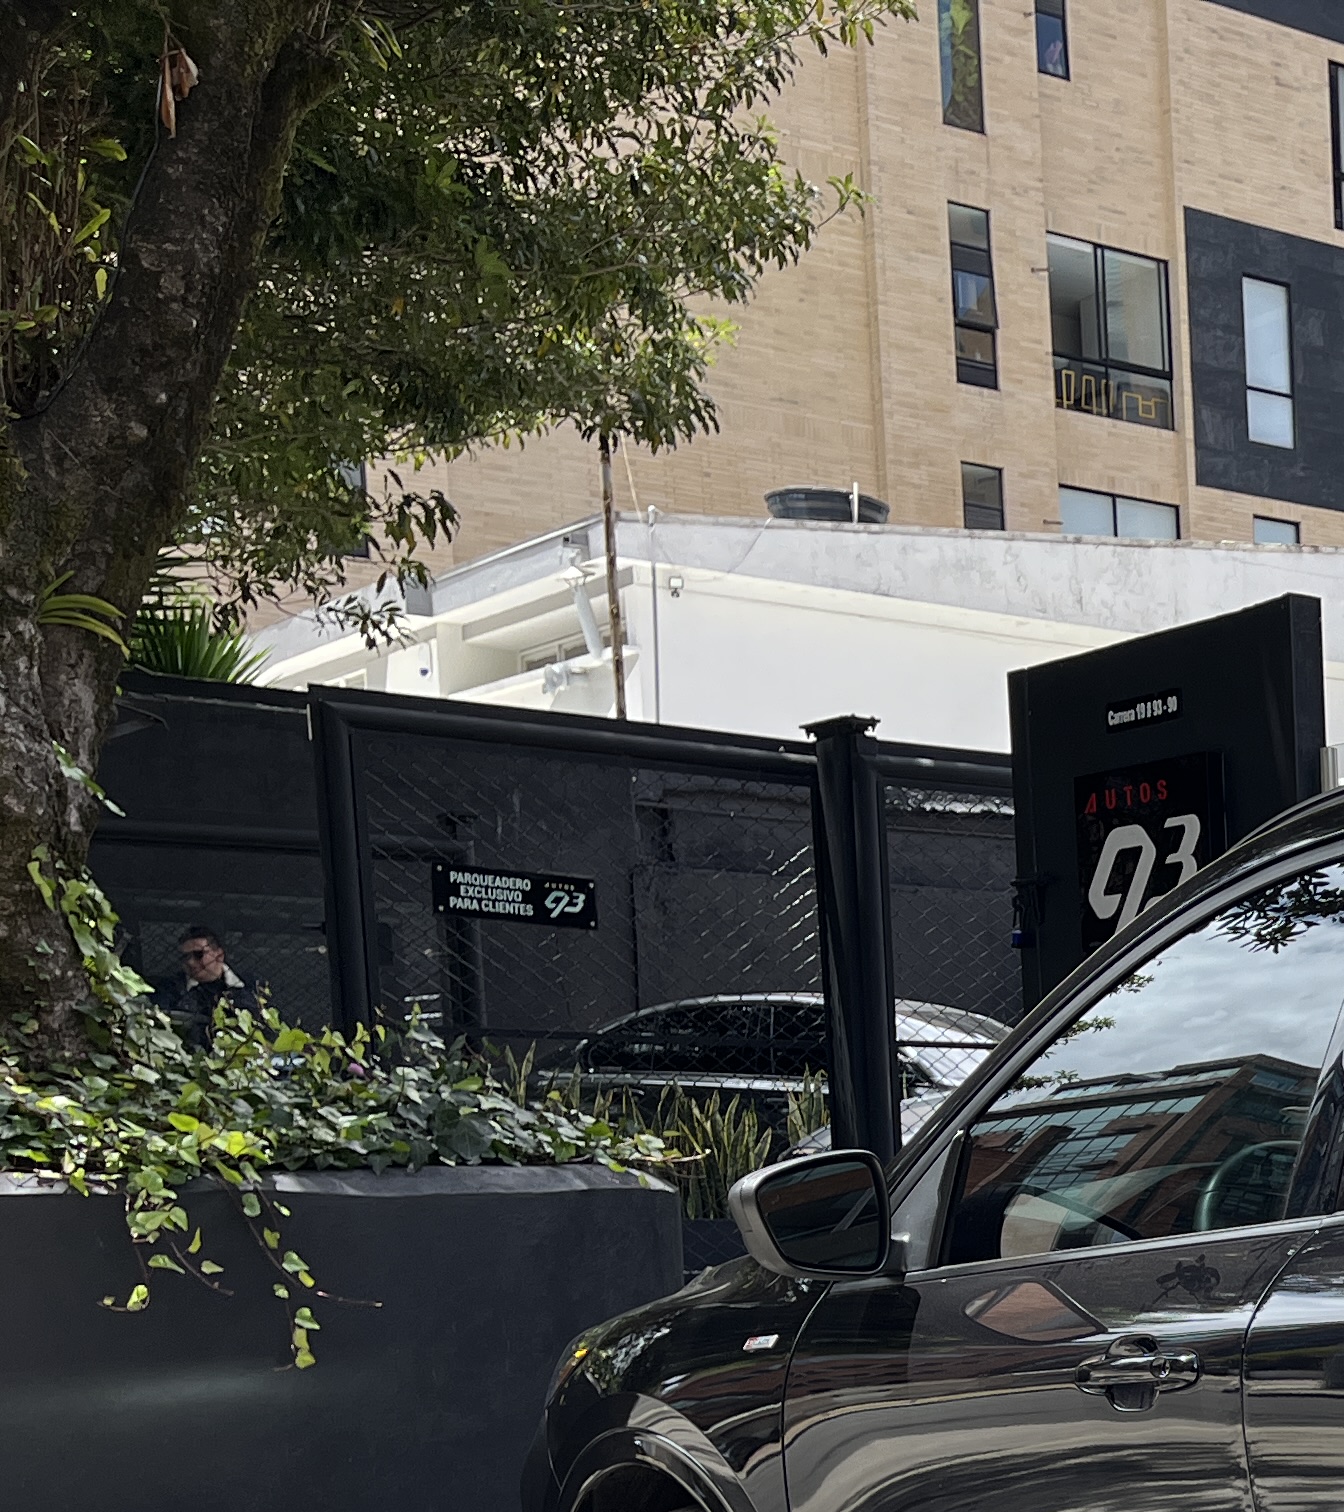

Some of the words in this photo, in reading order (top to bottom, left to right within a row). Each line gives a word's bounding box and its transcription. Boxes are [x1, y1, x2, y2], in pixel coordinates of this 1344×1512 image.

[1085, 779, 1168, 814] AUTOS
[450, 871, 531, 891] PARQUEADERO
[460, 885, 522, 902] EXCLUSIVO
[544, 890, 586, 918] 93
[450, 896, 479, 911] PARA
[481, 902, 534, 917] CLIENTES
